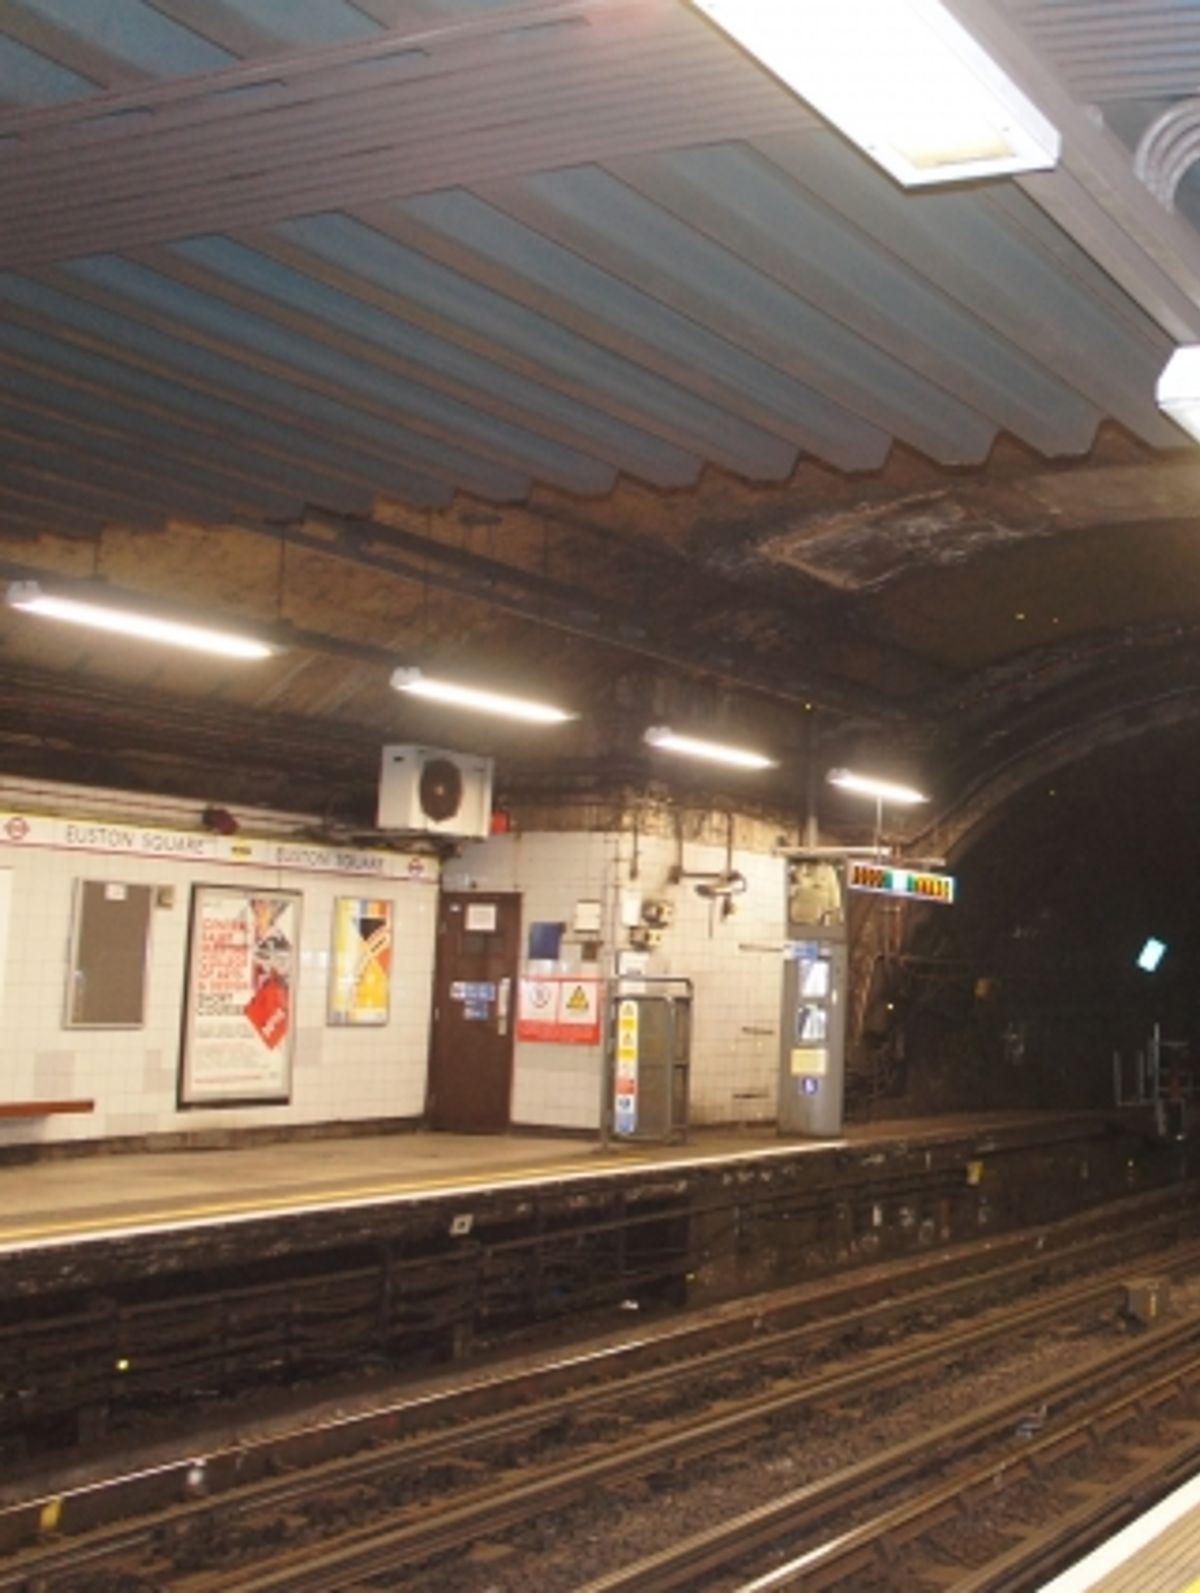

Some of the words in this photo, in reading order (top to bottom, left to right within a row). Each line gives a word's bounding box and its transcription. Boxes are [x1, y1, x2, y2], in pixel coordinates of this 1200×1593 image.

[66, 824, 133, 848] EUSTON
[141, 830, 204, 854] SQUARE
[276, 846, 330, 867] EUSTON
[336, 852, 384, 871] SQUARE
